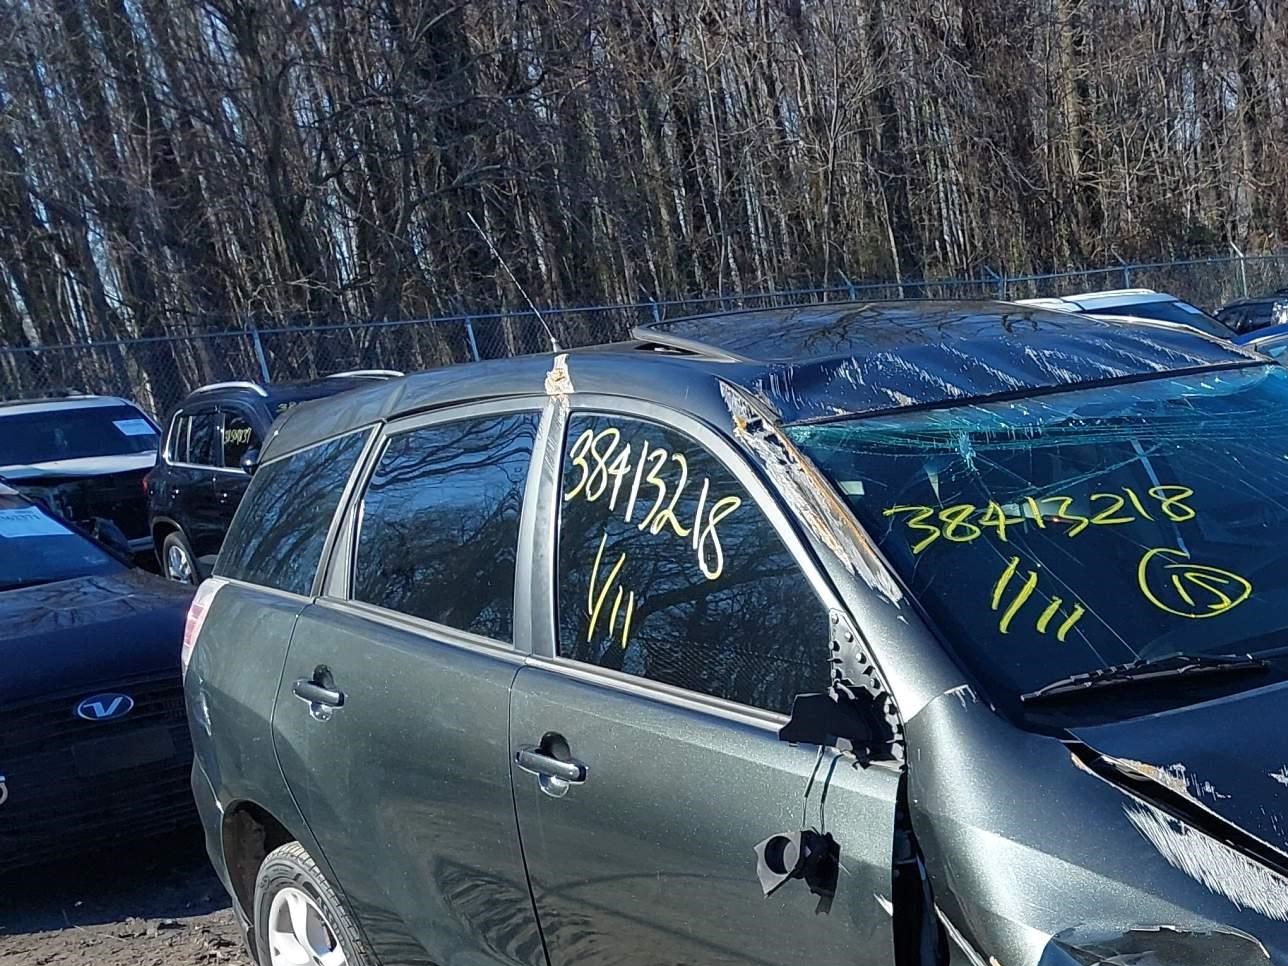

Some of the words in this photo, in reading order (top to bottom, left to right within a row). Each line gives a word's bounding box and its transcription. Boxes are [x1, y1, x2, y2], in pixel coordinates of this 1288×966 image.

[564, 428, 741, 580] 38413218
[883, 486, 1196, 554] 38413218
[587, 533, 634, 648] 1/11
[992, 556, 1086, 642] 1/11
